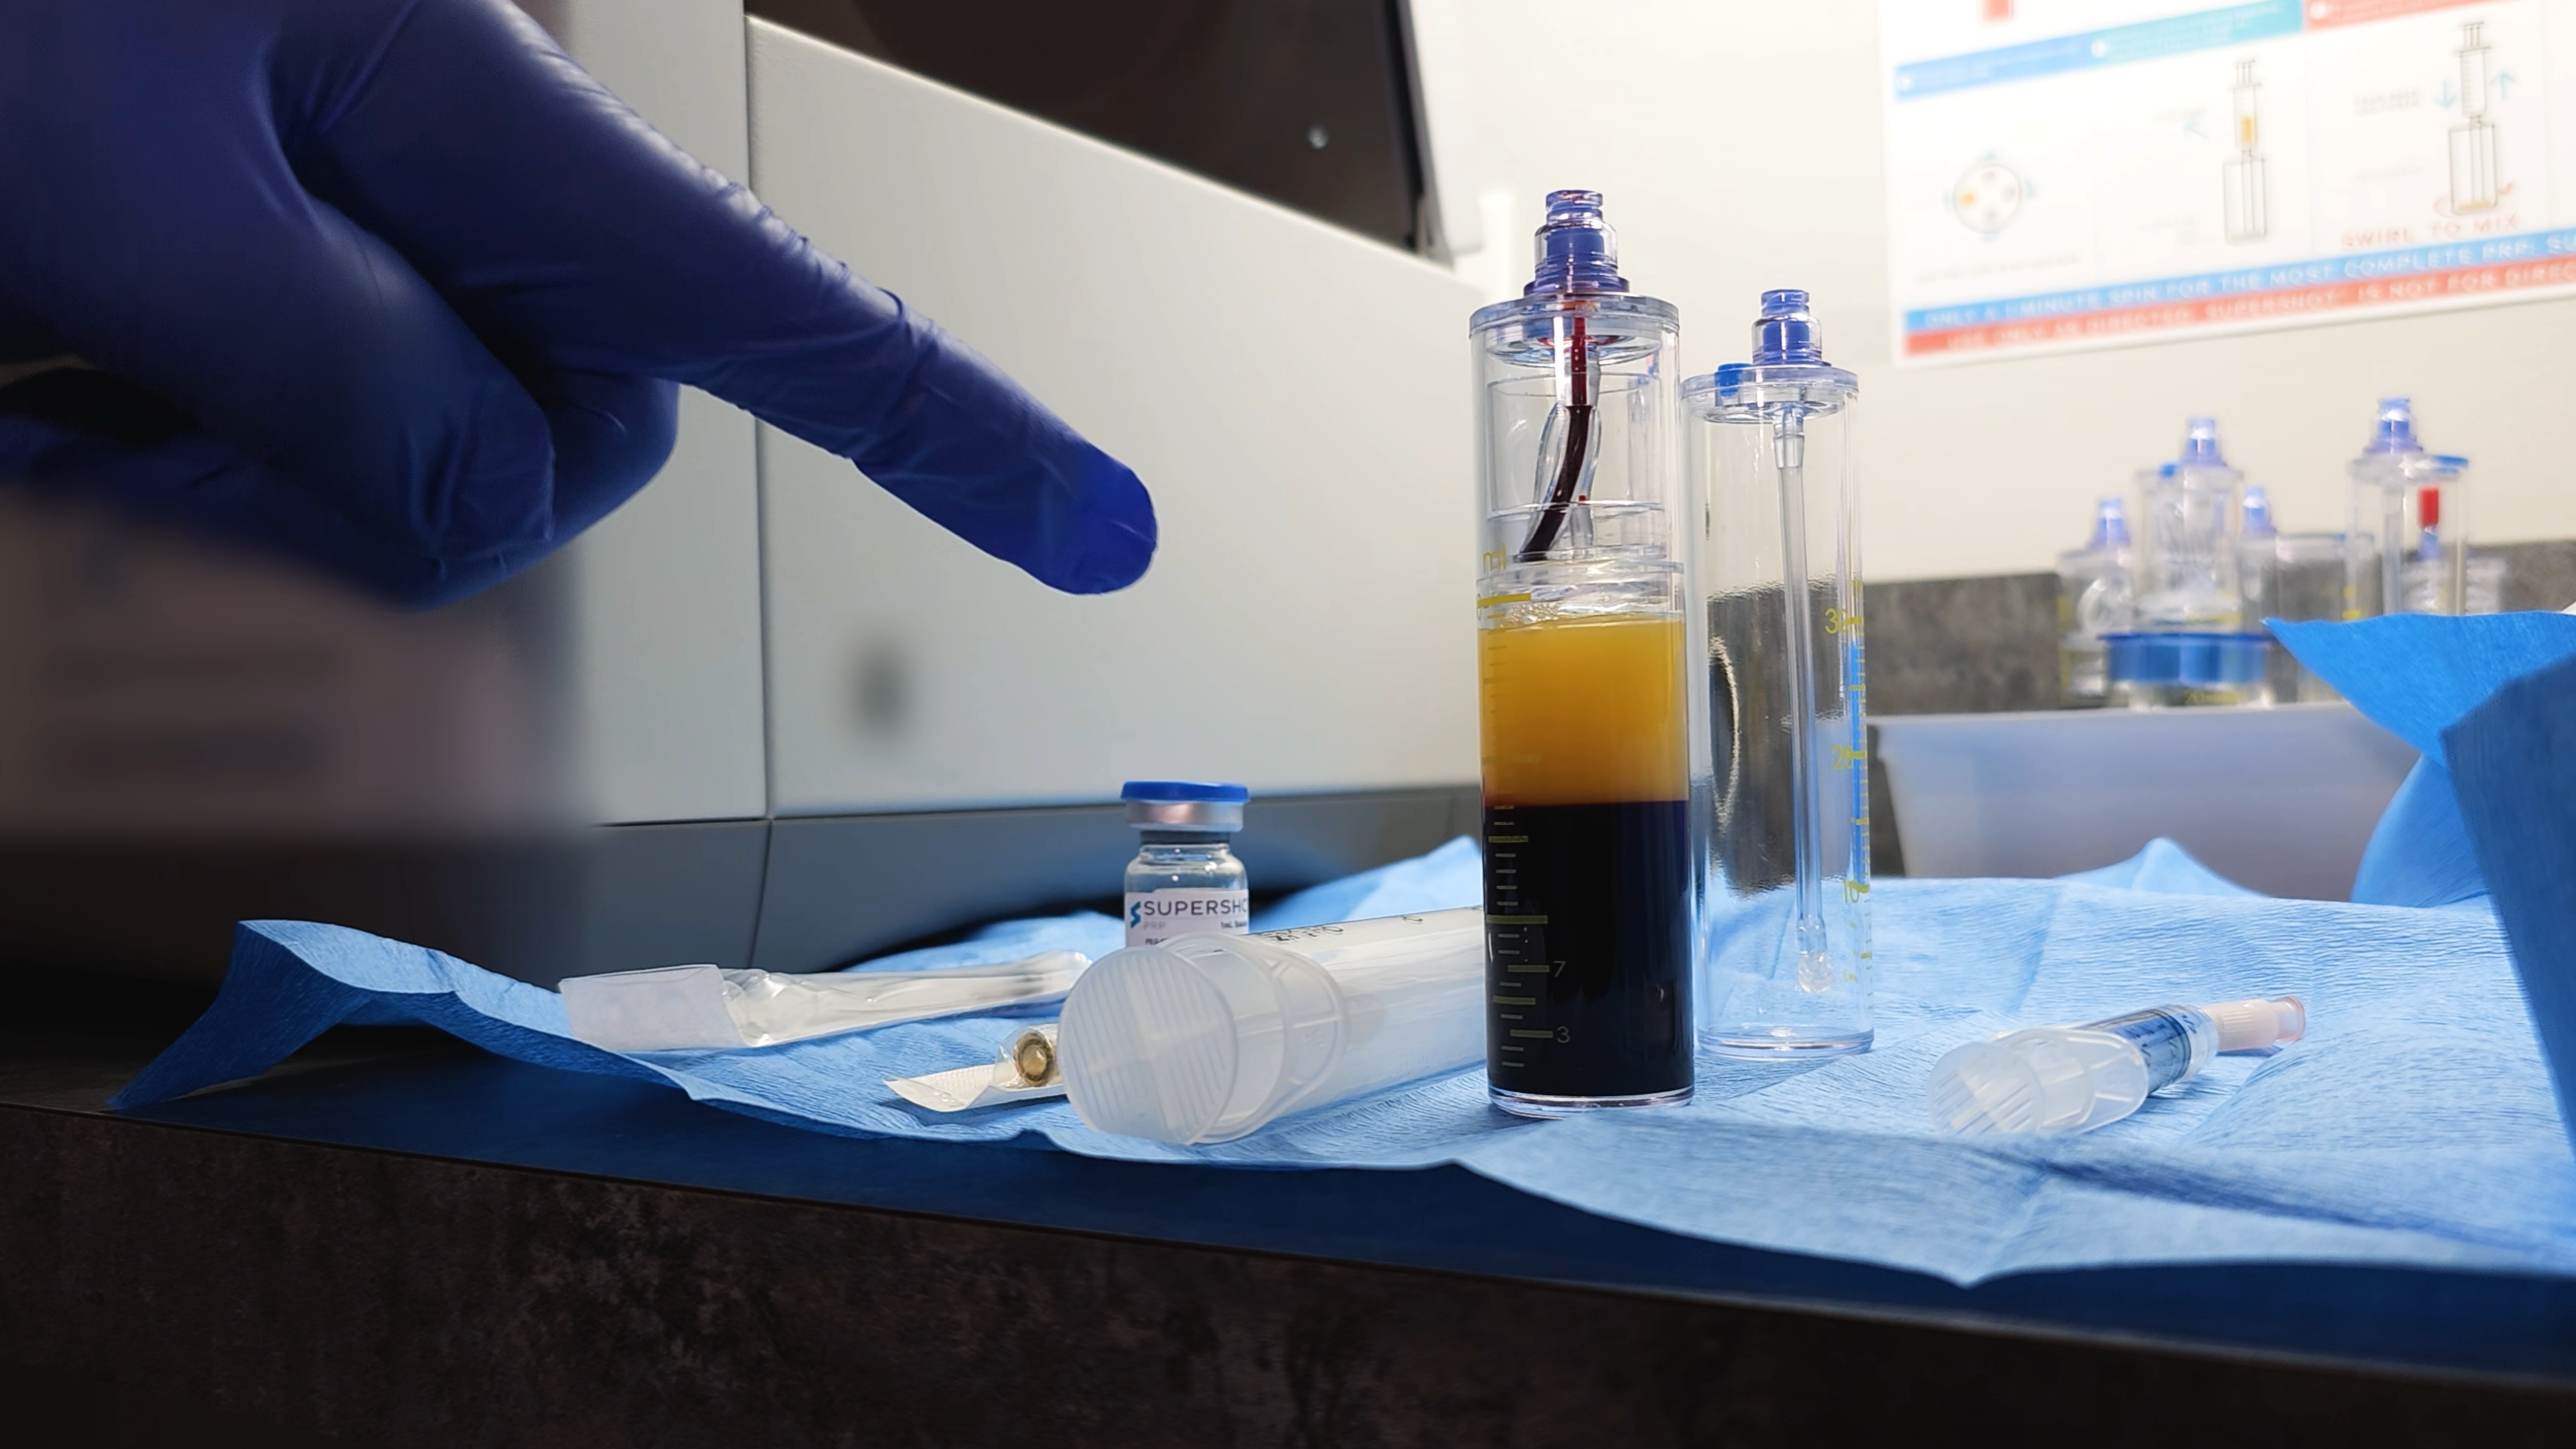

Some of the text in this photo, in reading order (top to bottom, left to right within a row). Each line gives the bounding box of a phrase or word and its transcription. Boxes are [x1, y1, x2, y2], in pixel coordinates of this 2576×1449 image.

[2342, 213, 2518, 251] SWIRL TO MIX
[1925, 307, 1976, 329] ONLY
[1984, 305, 1998, 321] A
[2109, 286, 2158, 307] SPIN
[2166, 278, 2209, 299] FOR
[2220, 272, 2263, 290] THE
[2270, 264, 2334, 286] MOST
[2344, 247, 2474, 278] COMPLETE
[2358, 284, 2382, 302] IS
[2389, 278, 2436, 299] NOT
[2448, 270, 2496, 292] FOR
[1143, 921, 1166, 930] PRP
[1553, 961, 1566, 977] 7
[1556, 1026, 1570, 1044] 3
